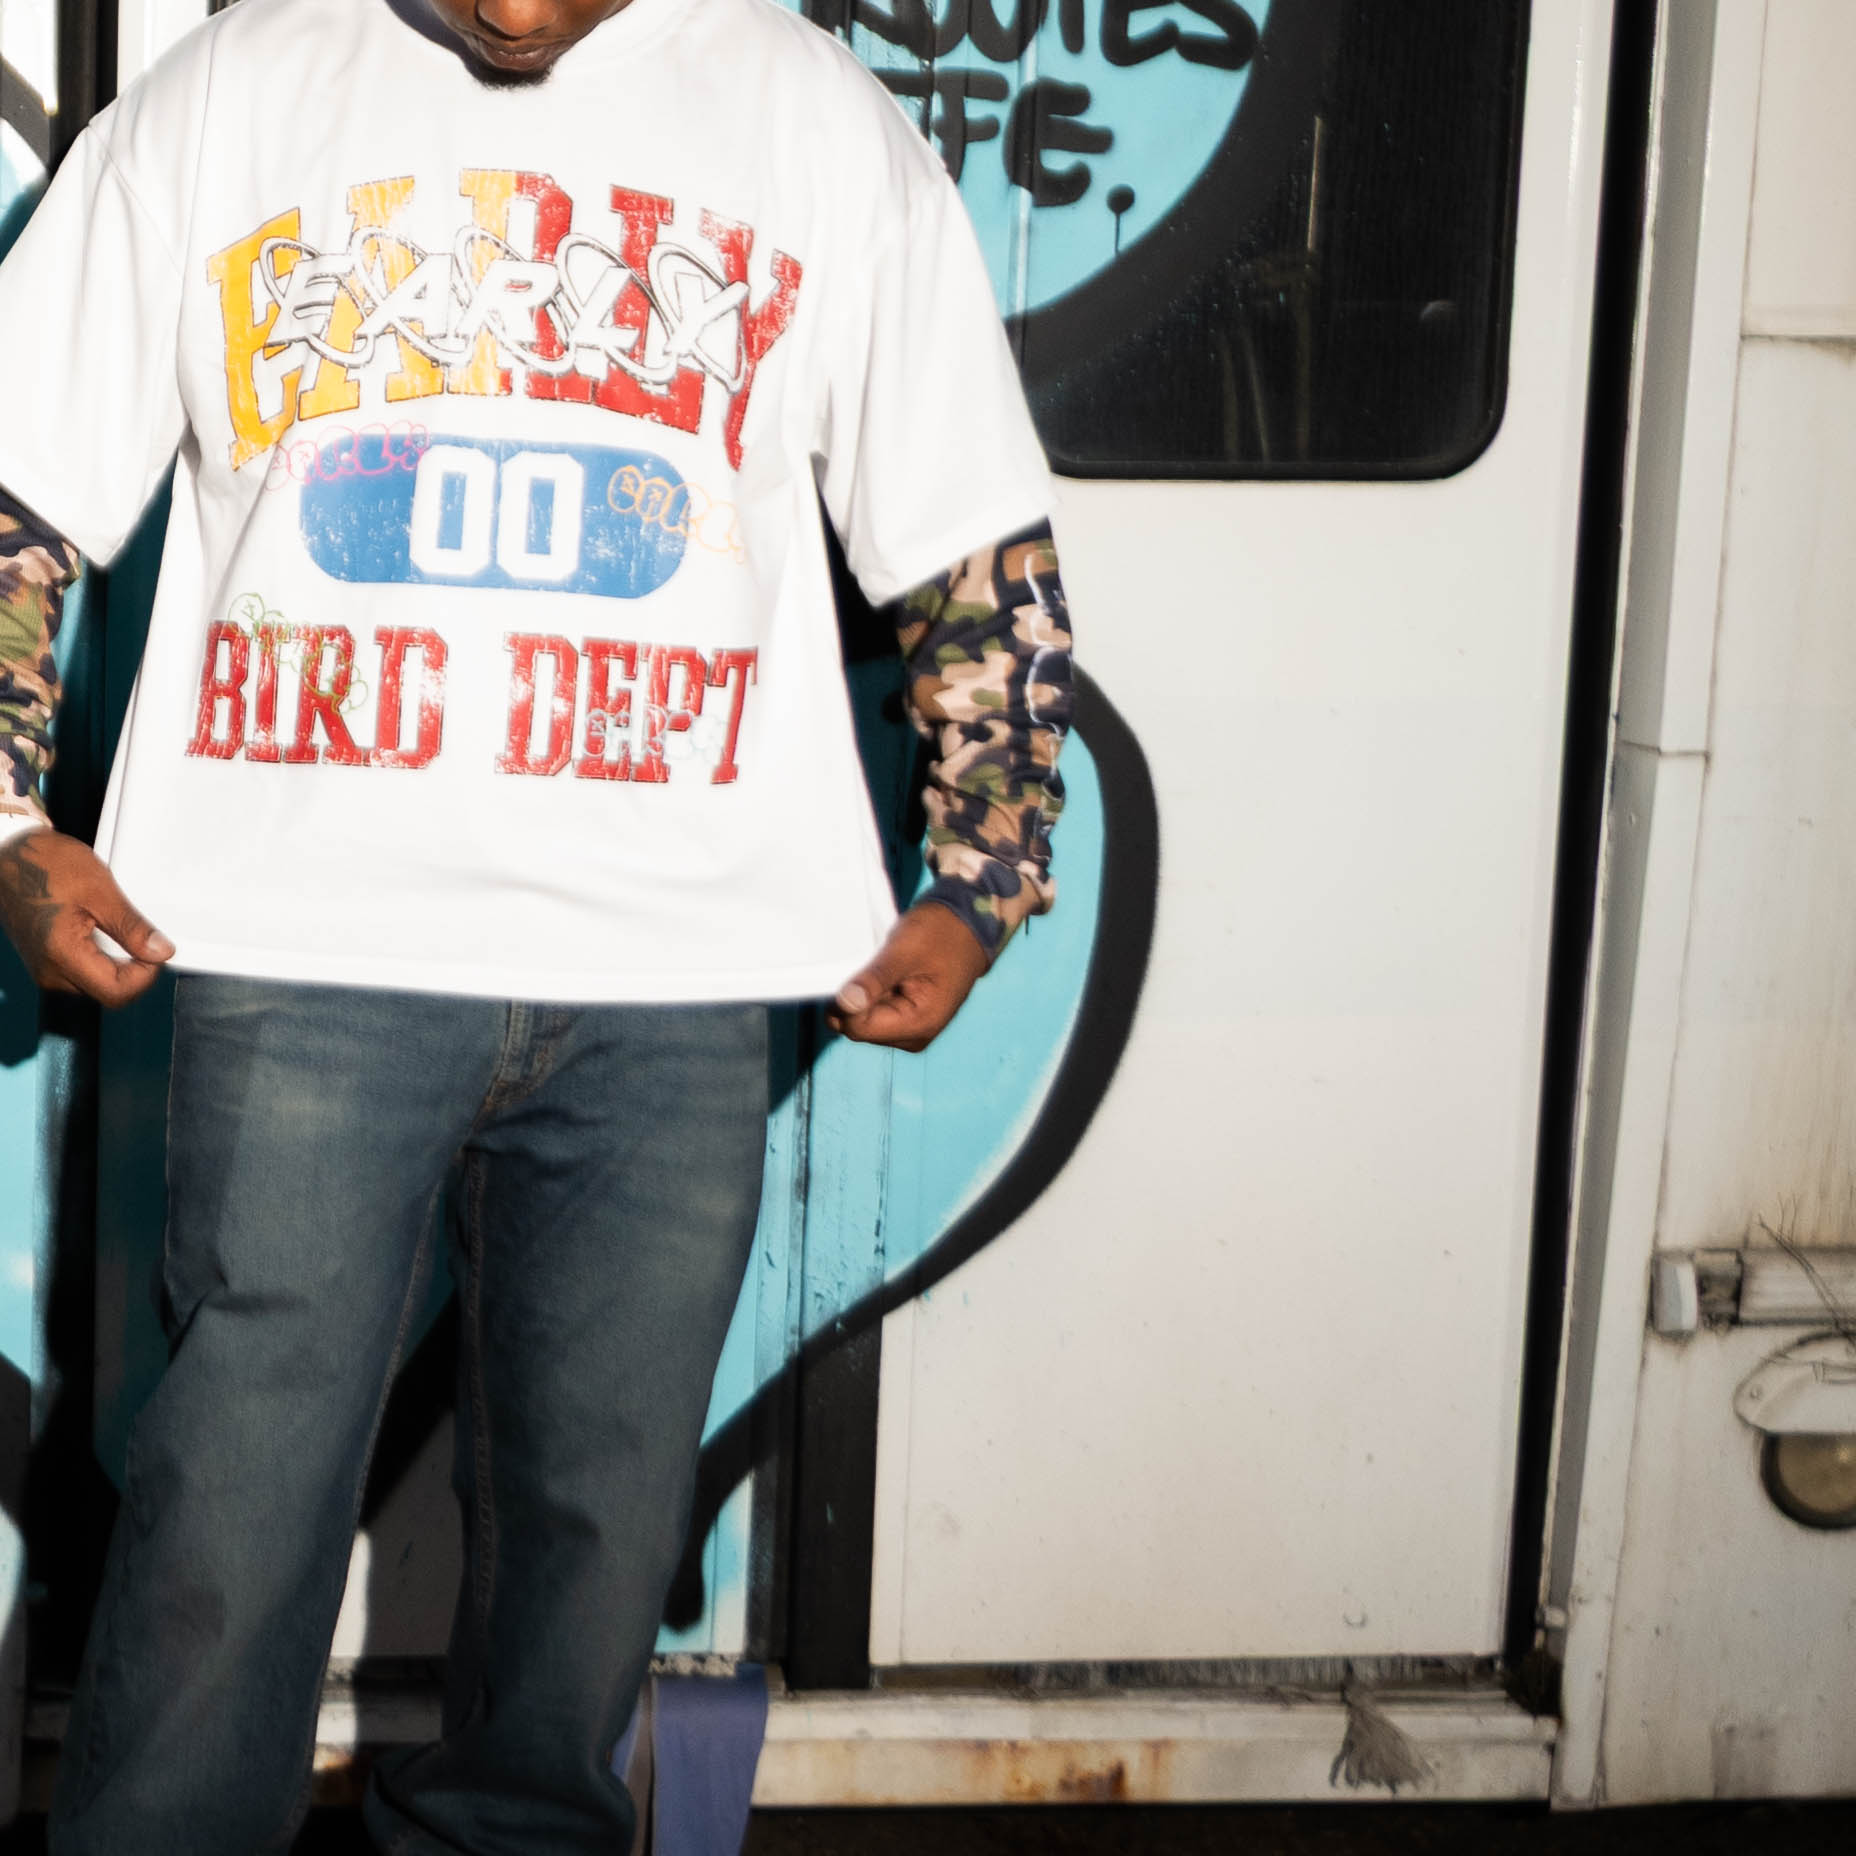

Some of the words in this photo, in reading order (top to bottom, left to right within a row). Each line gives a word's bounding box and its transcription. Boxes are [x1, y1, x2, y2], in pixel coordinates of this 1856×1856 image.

[207, 168, 804, 473] EARLY
[260, 228, 752, 391] EARLY
[410, 444, 585, 582] 00
[184, 620, 449, 770] BIRD
[494, 631, 760, 784] DEPT
